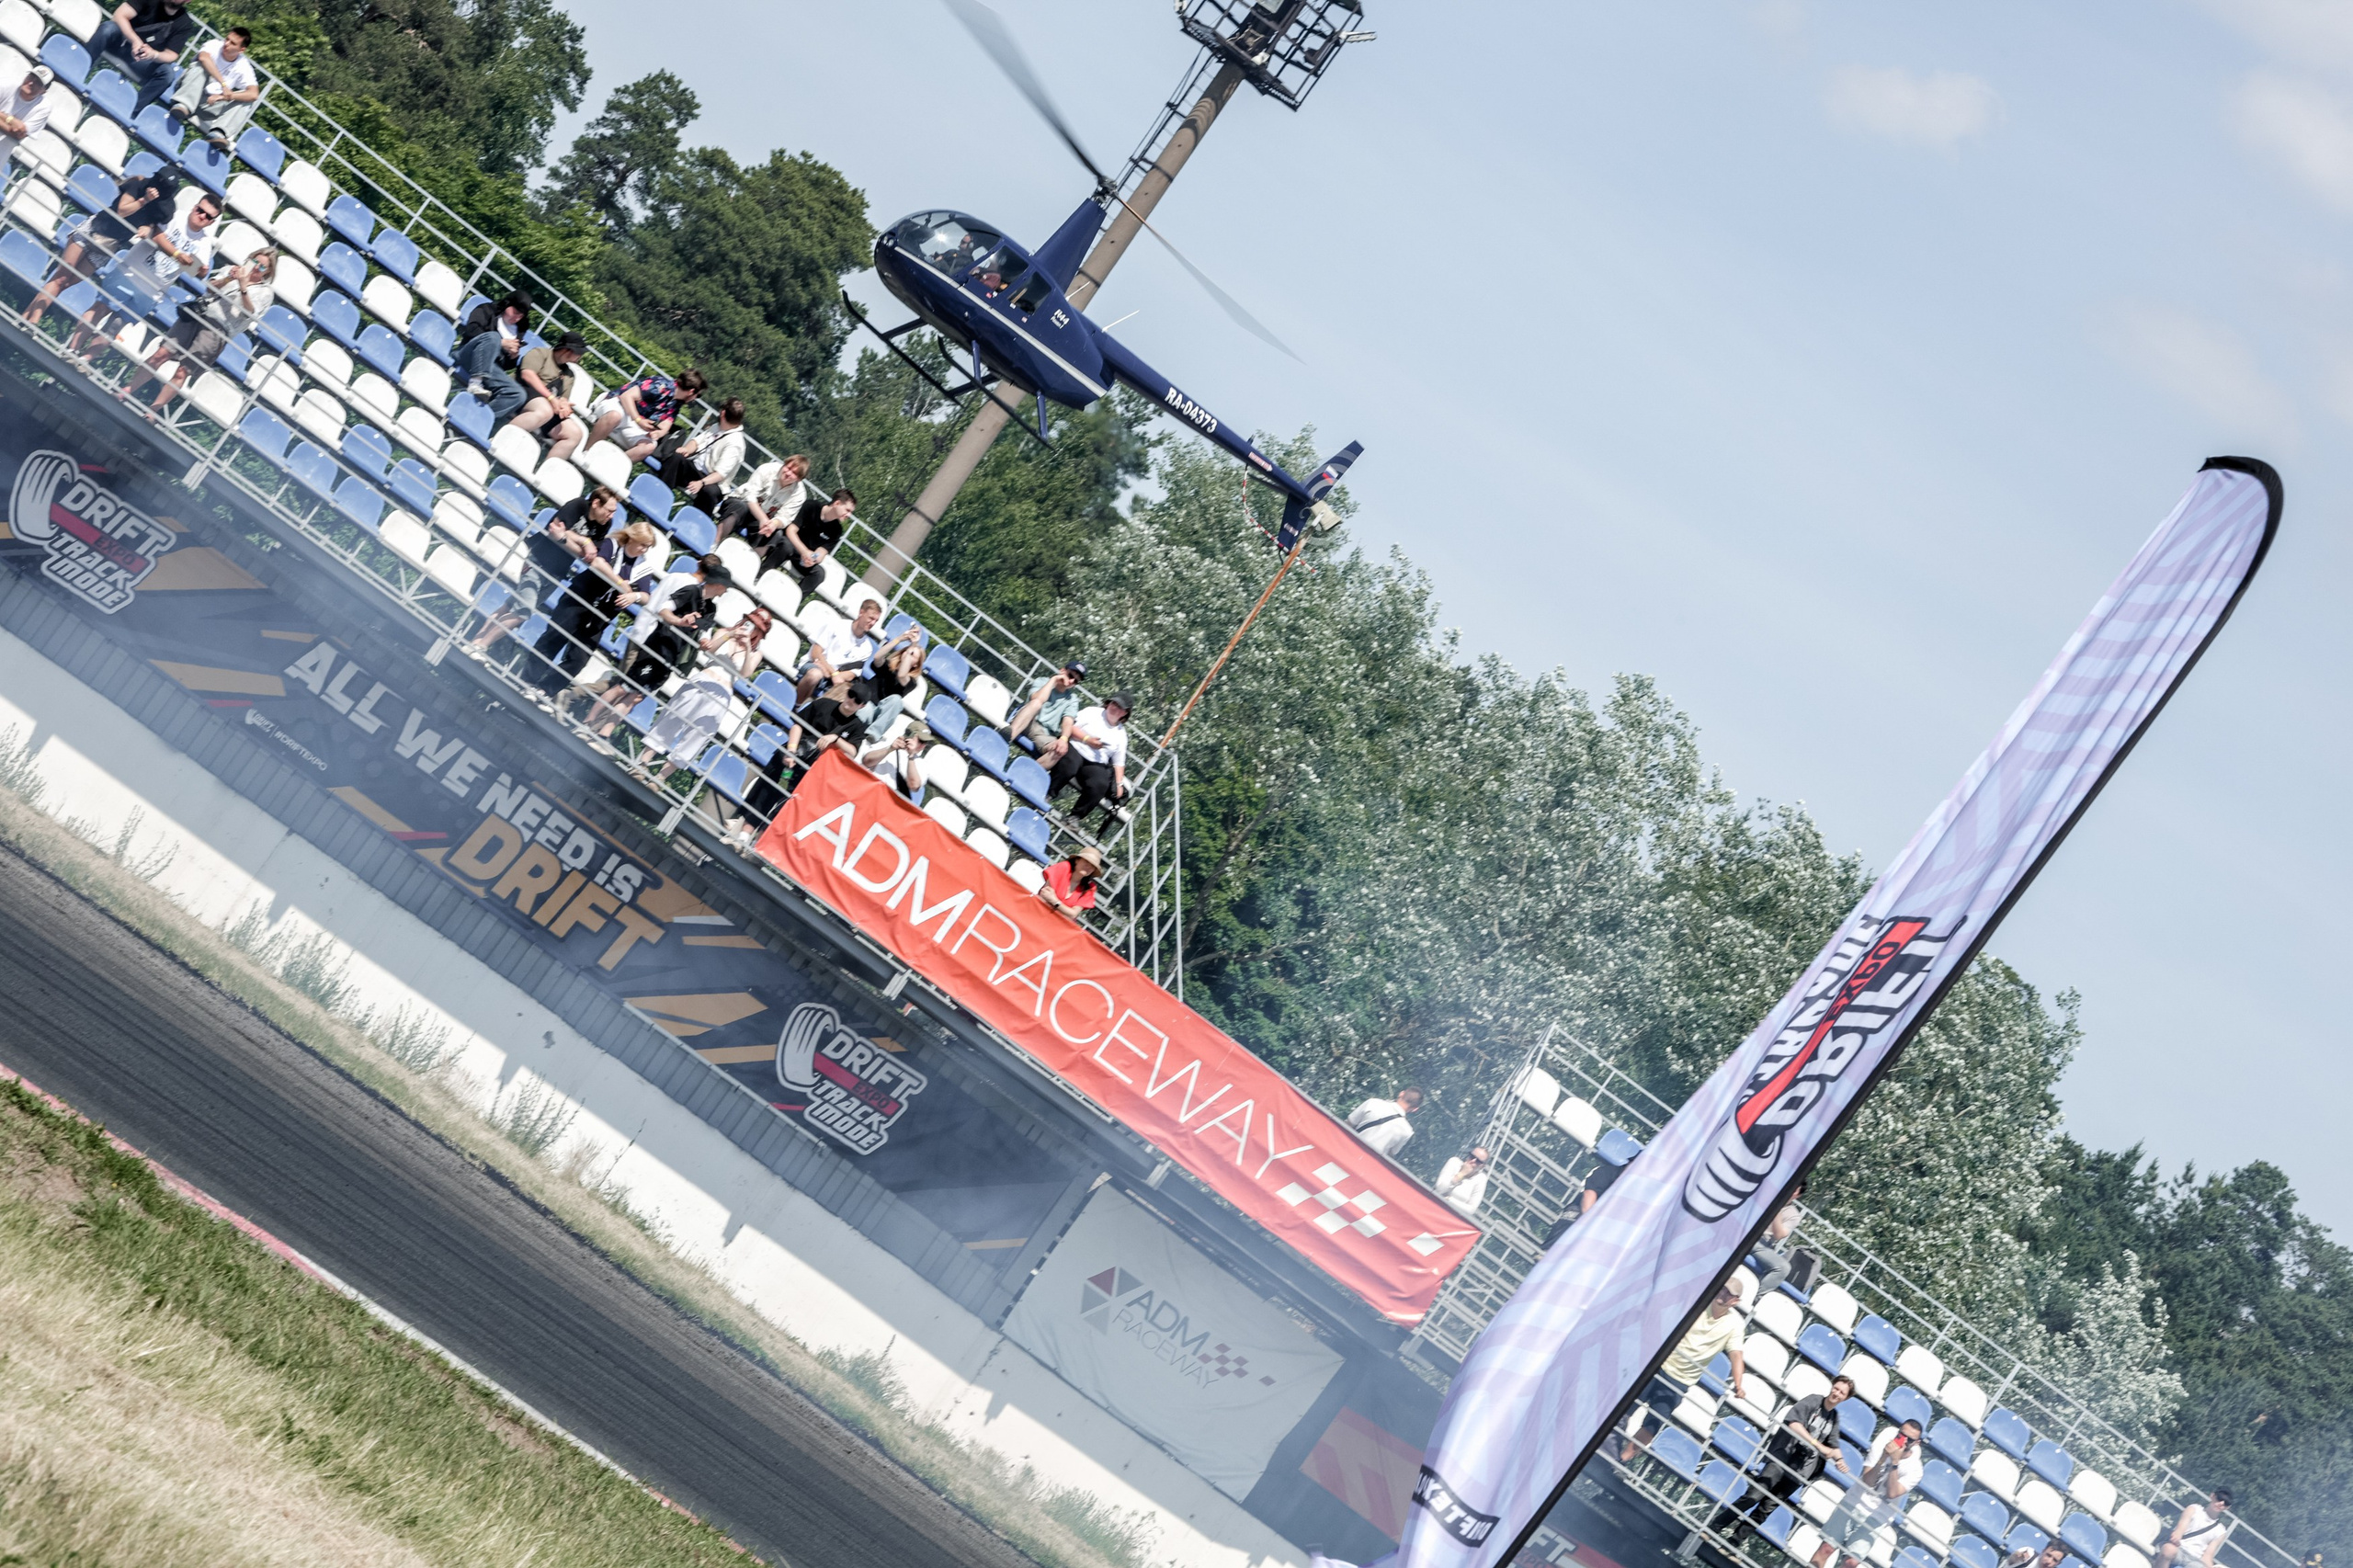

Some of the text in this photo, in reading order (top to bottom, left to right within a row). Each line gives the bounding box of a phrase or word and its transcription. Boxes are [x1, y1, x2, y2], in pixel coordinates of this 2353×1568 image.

[1164, 386, 1218, 434] RA-04373
[59, 483, 170, 560] DRIFT
[51, 532, 135, 589] TRACK
[94, 534, 136, 567] EXPO
[50, 556, 127, 608] MODE
[274, 730, 328, 771] #DRIFTEXPO
[284, 642, 646, 903] ALL WE NEED IS
[448, 812, 666, 972] DRIFT
[821, 1031, 921, 1099] DRIFT
[814, 1080, 888, 1131] TRACK
[851, 1083, 890, 1111] EXPO
[811, 1103, 881, 1149] MODE
[1111, 1308, 1220, 1390] RACEWAY
[1125, 1289, 1211, 1357] ADM
